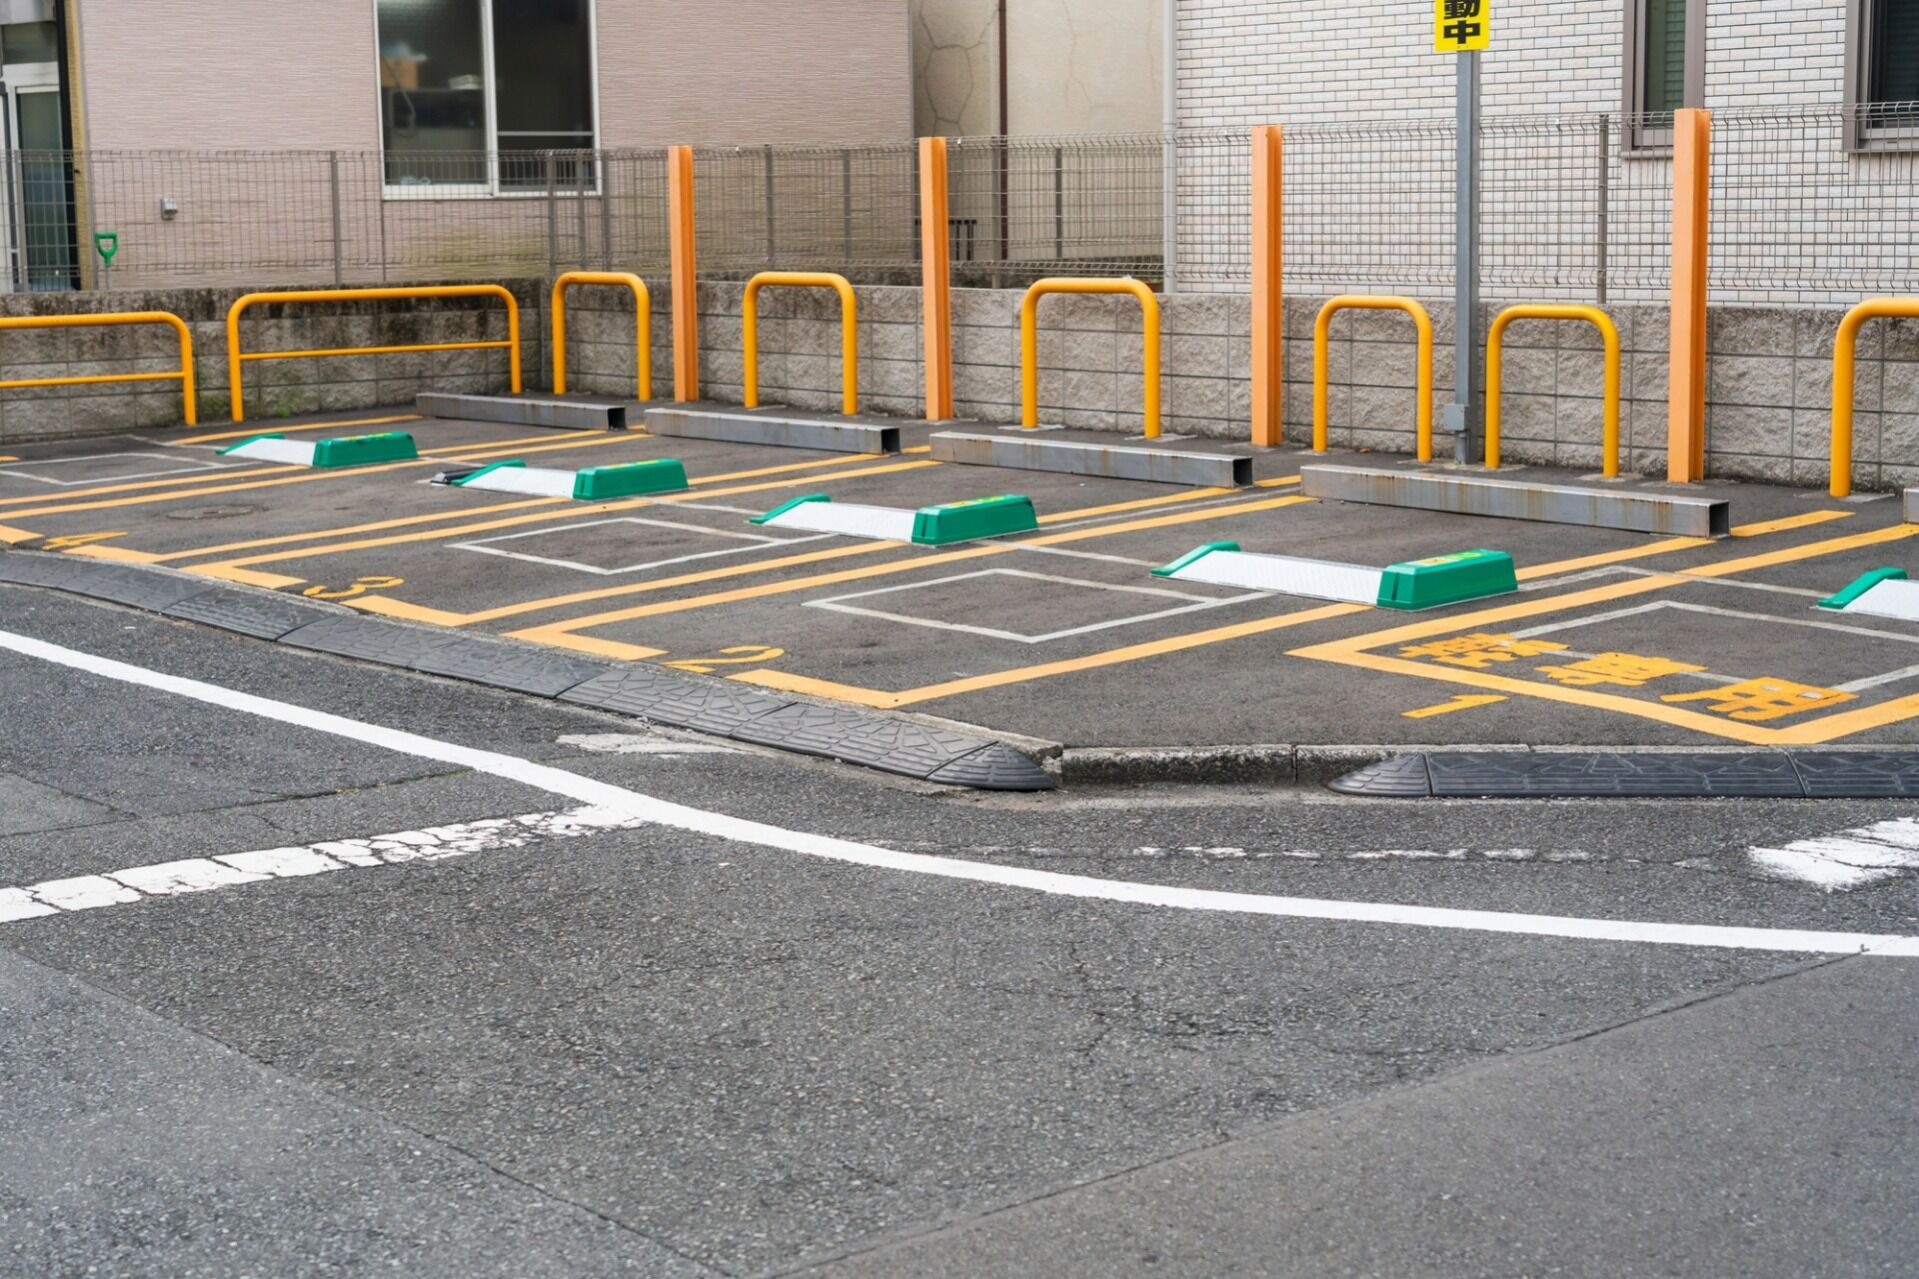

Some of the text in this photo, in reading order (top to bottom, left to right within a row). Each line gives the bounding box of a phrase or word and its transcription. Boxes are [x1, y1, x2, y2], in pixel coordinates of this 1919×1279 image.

[42, 531, 129, 551] 4
[303, 576, 404, 599] 3
[661, 645, 785, 673] 2
[1399, 633, 1860, 721] 軽専用
